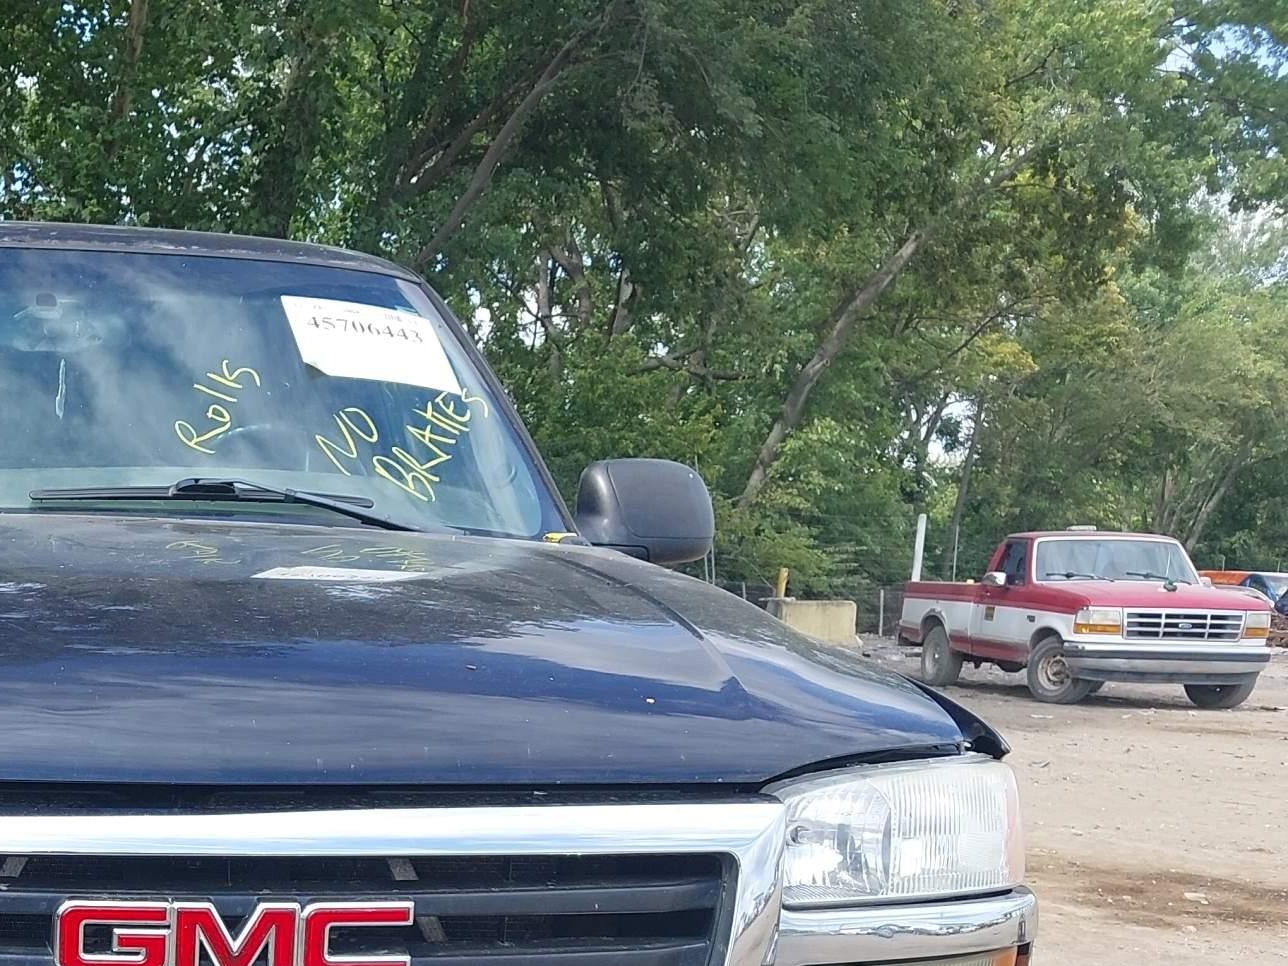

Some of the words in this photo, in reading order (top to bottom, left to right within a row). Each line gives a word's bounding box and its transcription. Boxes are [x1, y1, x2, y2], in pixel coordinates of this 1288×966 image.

[307, 316, 424, 343] 45706443
[315, 407, 379, 477] NO
[373, 387, 489, 502] BRAKES
